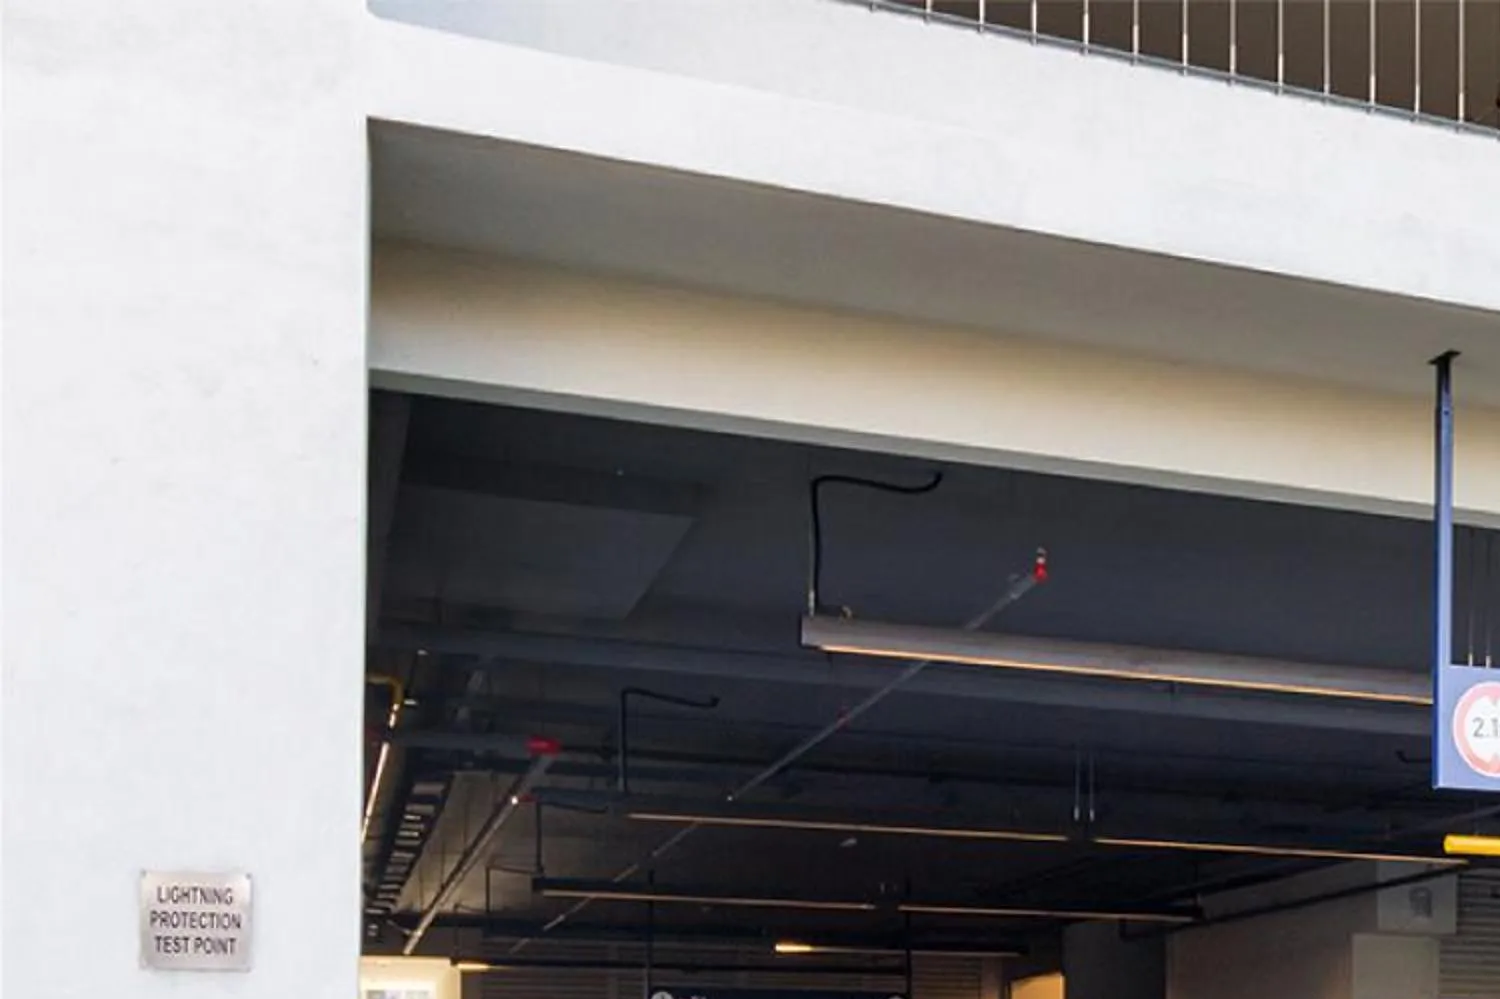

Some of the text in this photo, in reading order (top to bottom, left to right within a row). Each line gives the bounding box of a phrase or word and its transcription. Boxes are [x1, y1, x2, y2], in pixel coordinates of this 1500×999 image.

[157, 885, 233, 905] LIGHTNING
[150, 910, 242, 930] PROTECTION
[155, 935, 237, 955] TEST POINT
